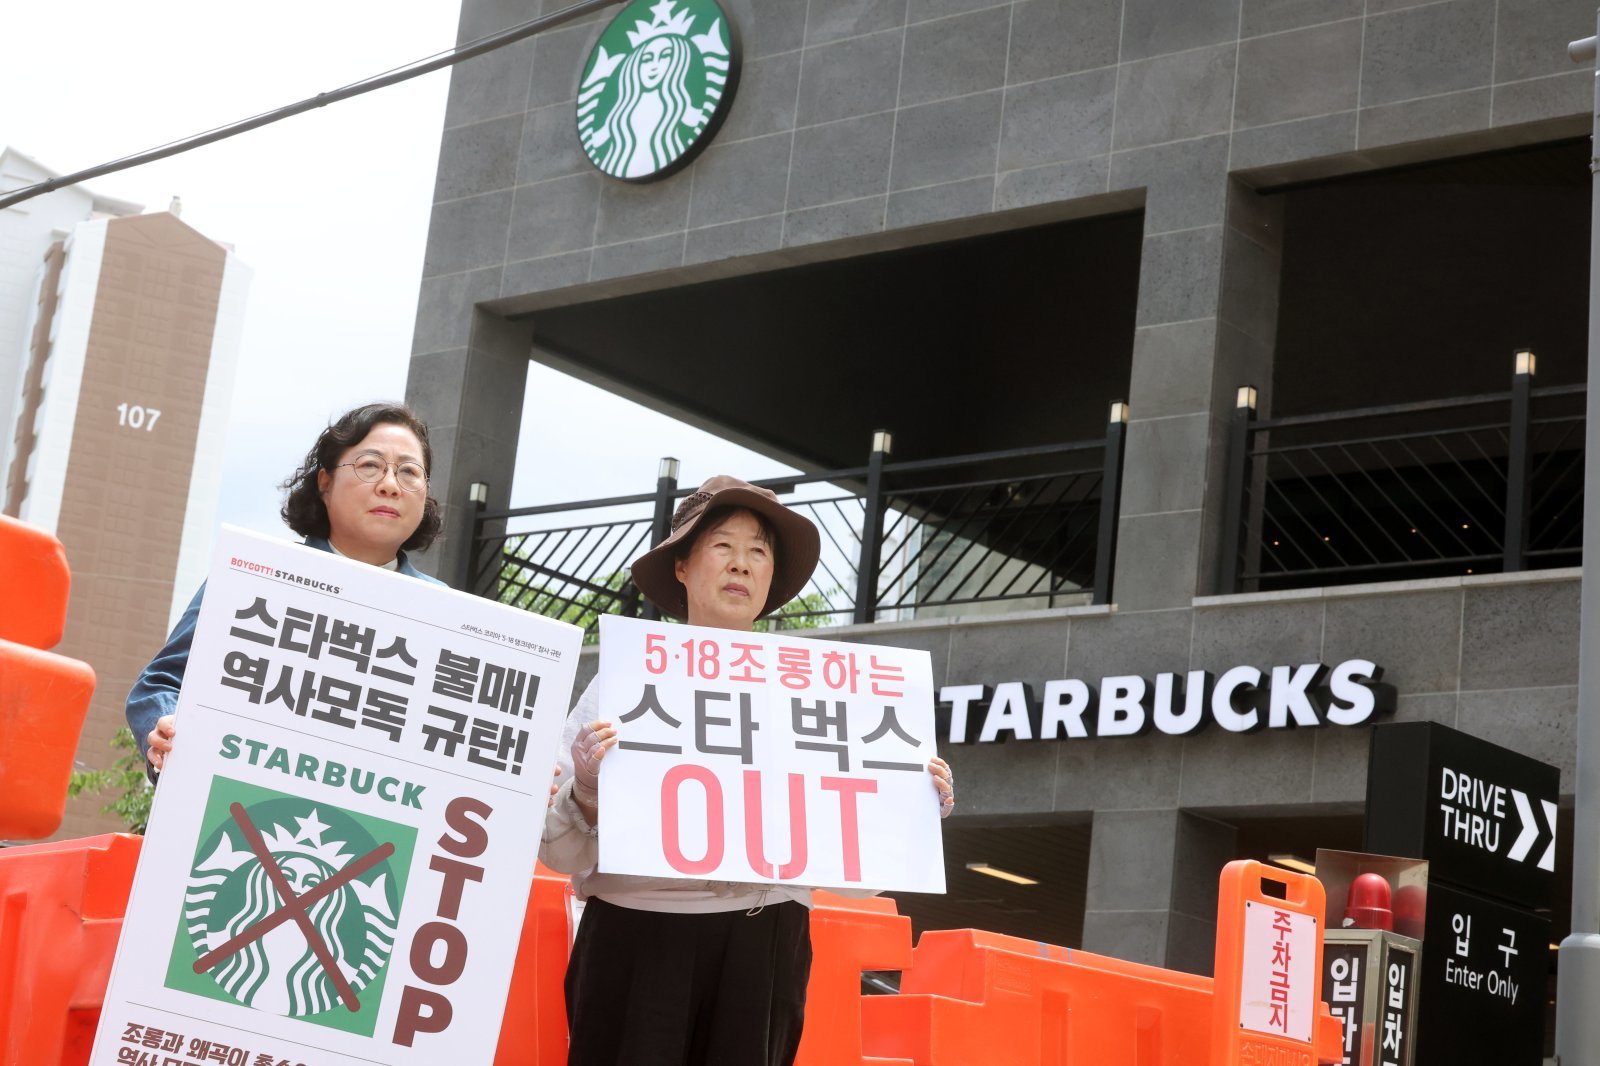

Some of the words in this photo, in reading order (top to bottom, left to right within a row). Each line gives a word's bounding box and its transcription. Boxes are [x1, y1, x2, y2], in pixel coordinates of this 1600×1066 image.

[117, 403, 161, 432] 107
[230, 557, 274, 576] BOYCOTT!
[274, 570, 341, 594] STARBUCKS
[229, 597, 418, 685] 스타벅스
[432, 648, 541, 720] 불매!
[220, 651, 410, 743] 역사모독
[421, 704, 529, 775] 규탄!
[940, 659, 1376, 743] TARBUCKS
[218, 733, 427, 810] STARBUCK
[1441, 767, 1506, 818] DRIVE
[660, 763, 878, 882] OUT
[1440, 804, 1500, 852] THRU
[392, 796, 493, 1047] STOP
[1268, 910, 1292, 1033] 주차금지
[1445, 958, 1484, 990] Enter
[1487, 970, 1519, 1005] Only
[121, 1022, 183, 1054] 조롱과
[1382, 963, 1405, 1066] 입차
